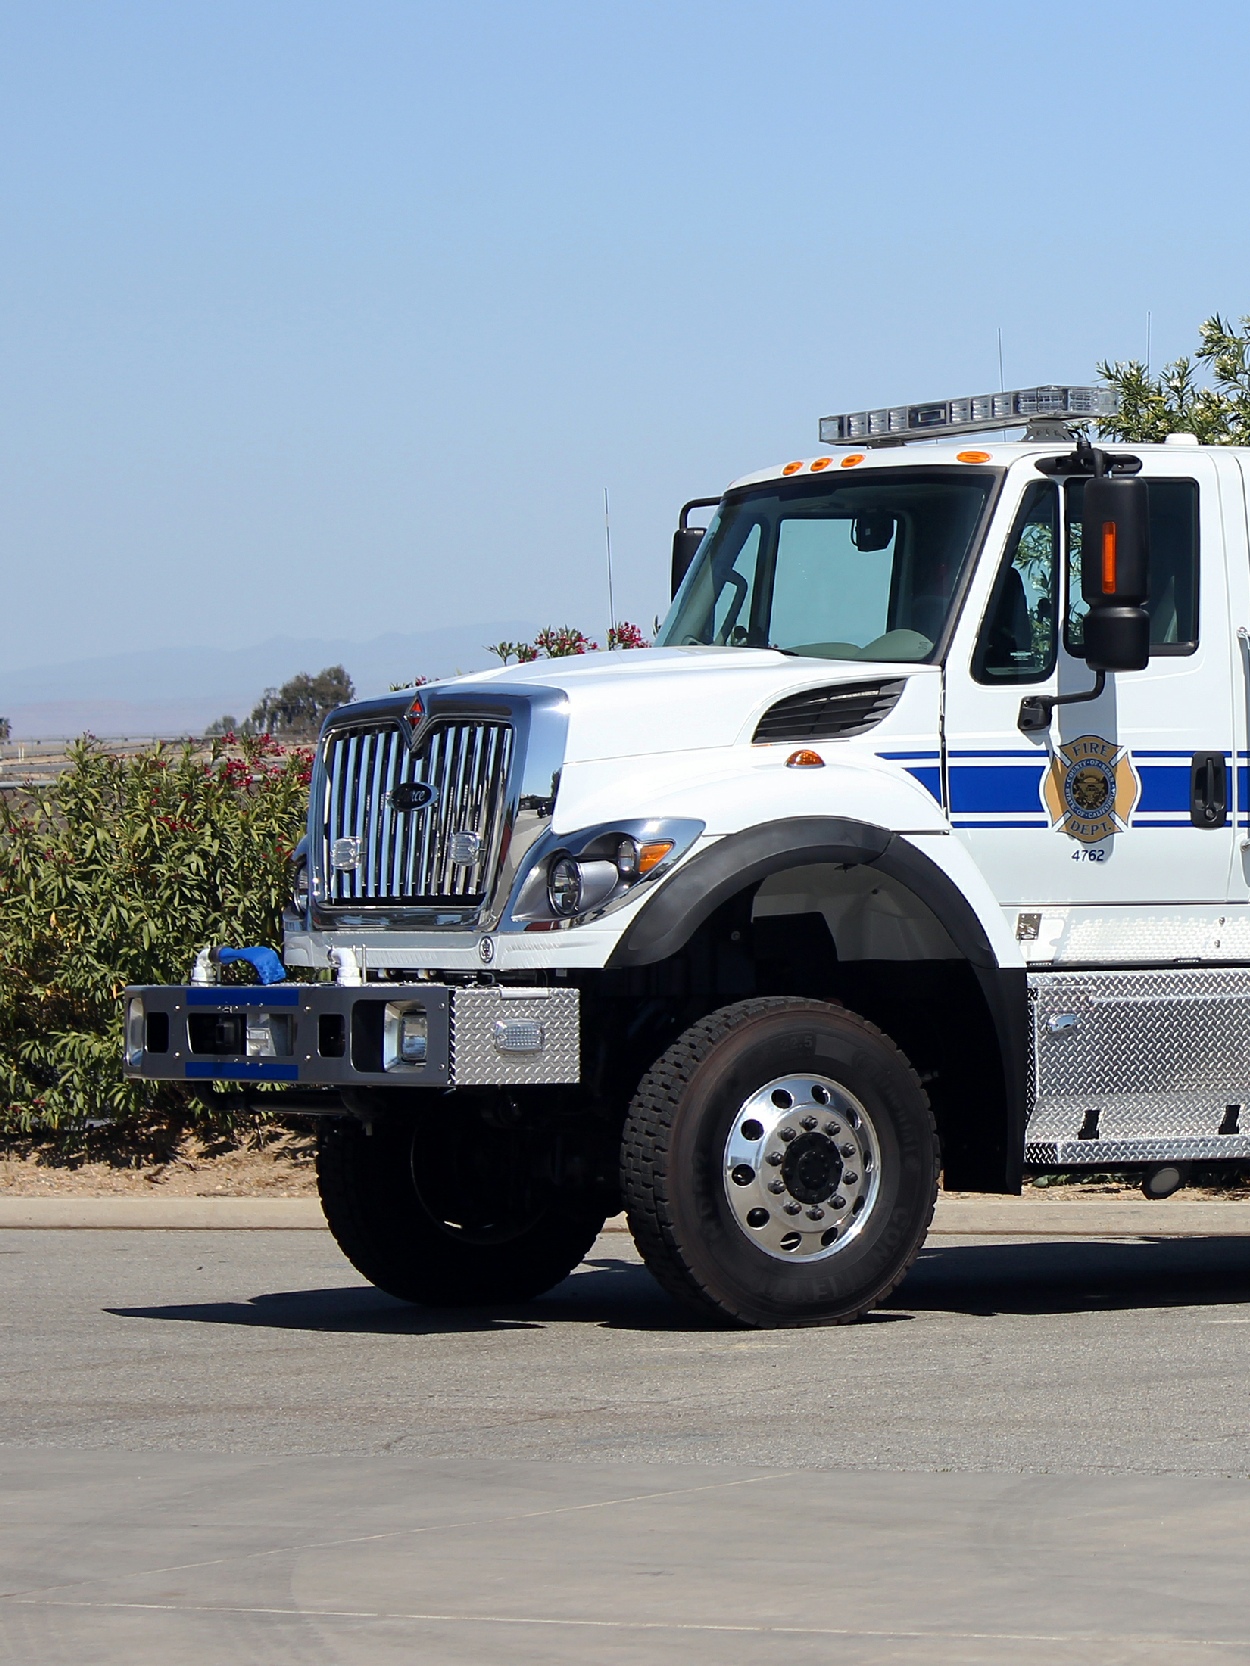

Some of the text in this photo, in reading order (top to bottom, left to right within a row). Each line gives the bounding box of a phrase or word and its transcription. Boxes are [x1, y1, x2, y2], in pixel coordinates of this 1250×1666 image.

[1072, 742, 1111, 758] FIRE
[1070, 820, 1112, 837] DEPT.
[1071, 849, 1106, 863] 4762
